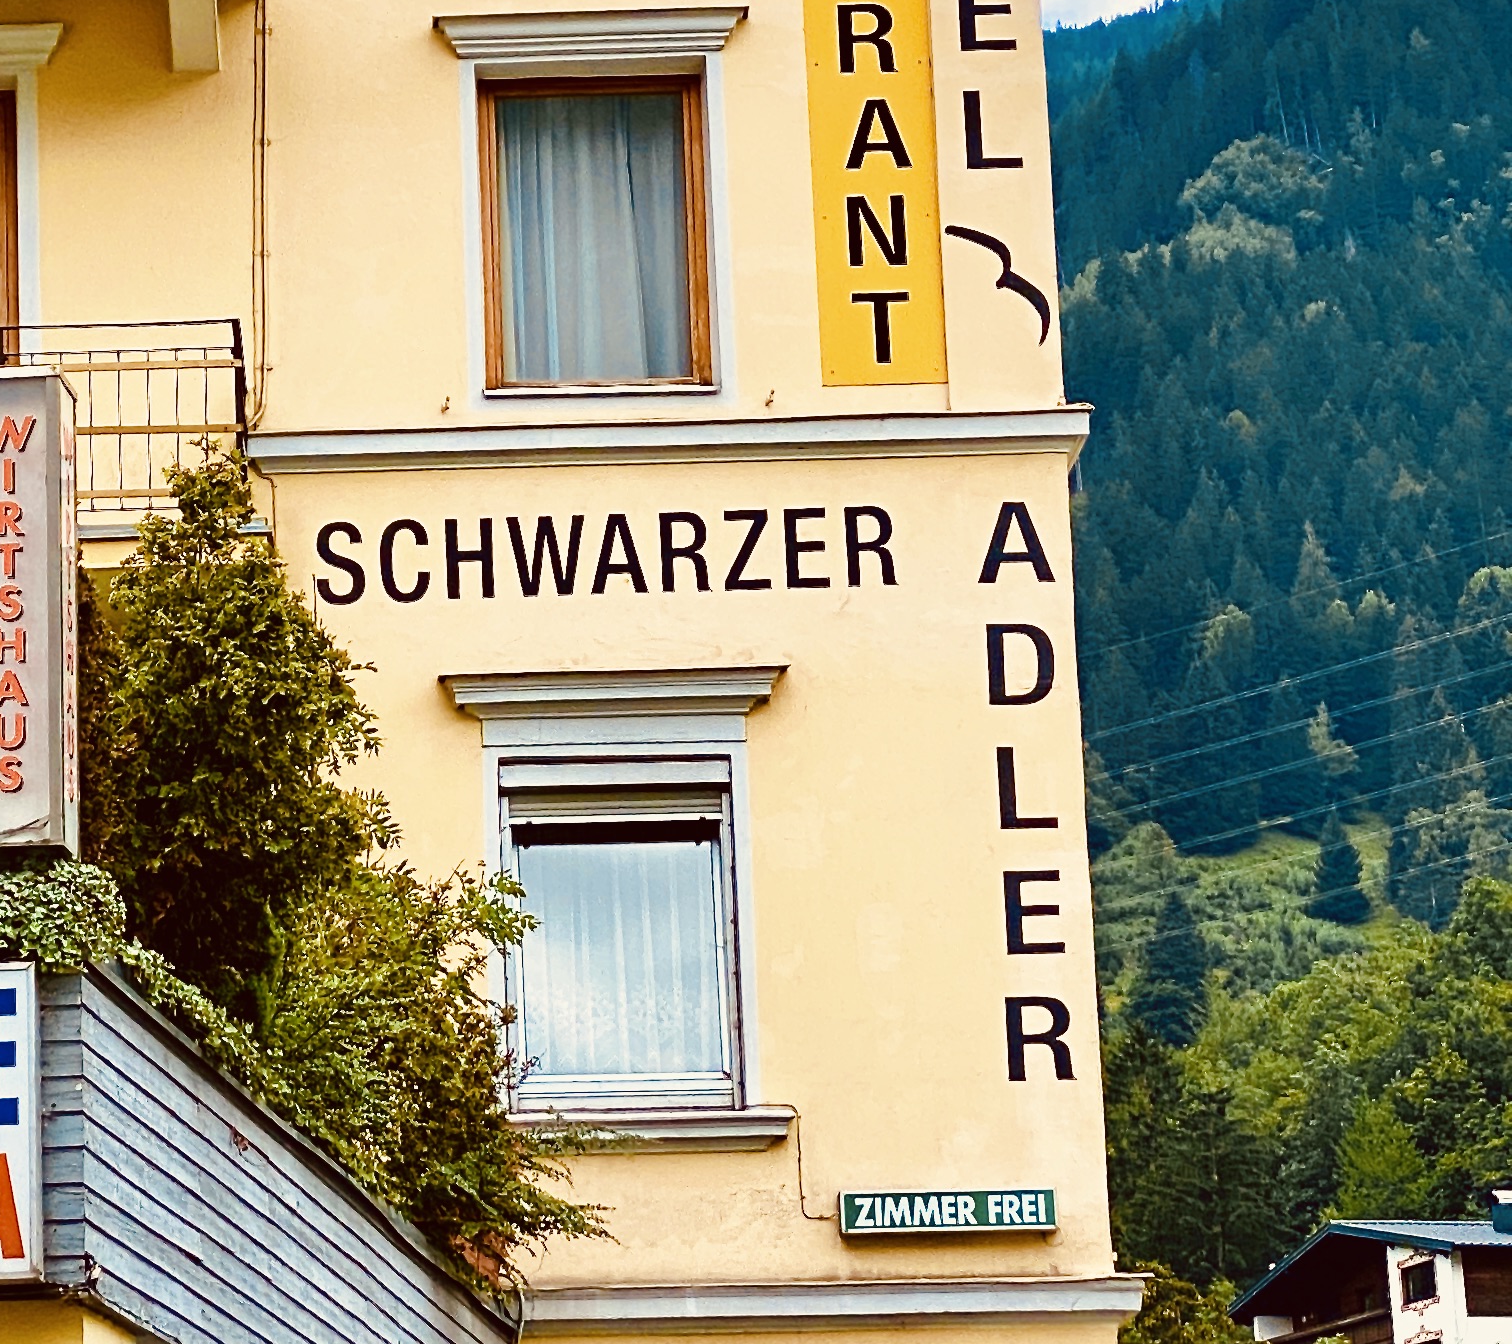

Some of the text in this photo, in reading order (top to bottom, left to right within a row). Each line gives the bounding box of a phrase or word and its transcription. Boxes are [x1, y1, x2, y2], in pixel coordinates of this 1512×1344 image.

[315, 504, 900, 606] SCHWARZER
[977, 501, 1077, 1083] ADLER
[854, 1193, 1047, 1227] ZIMMER FREI
